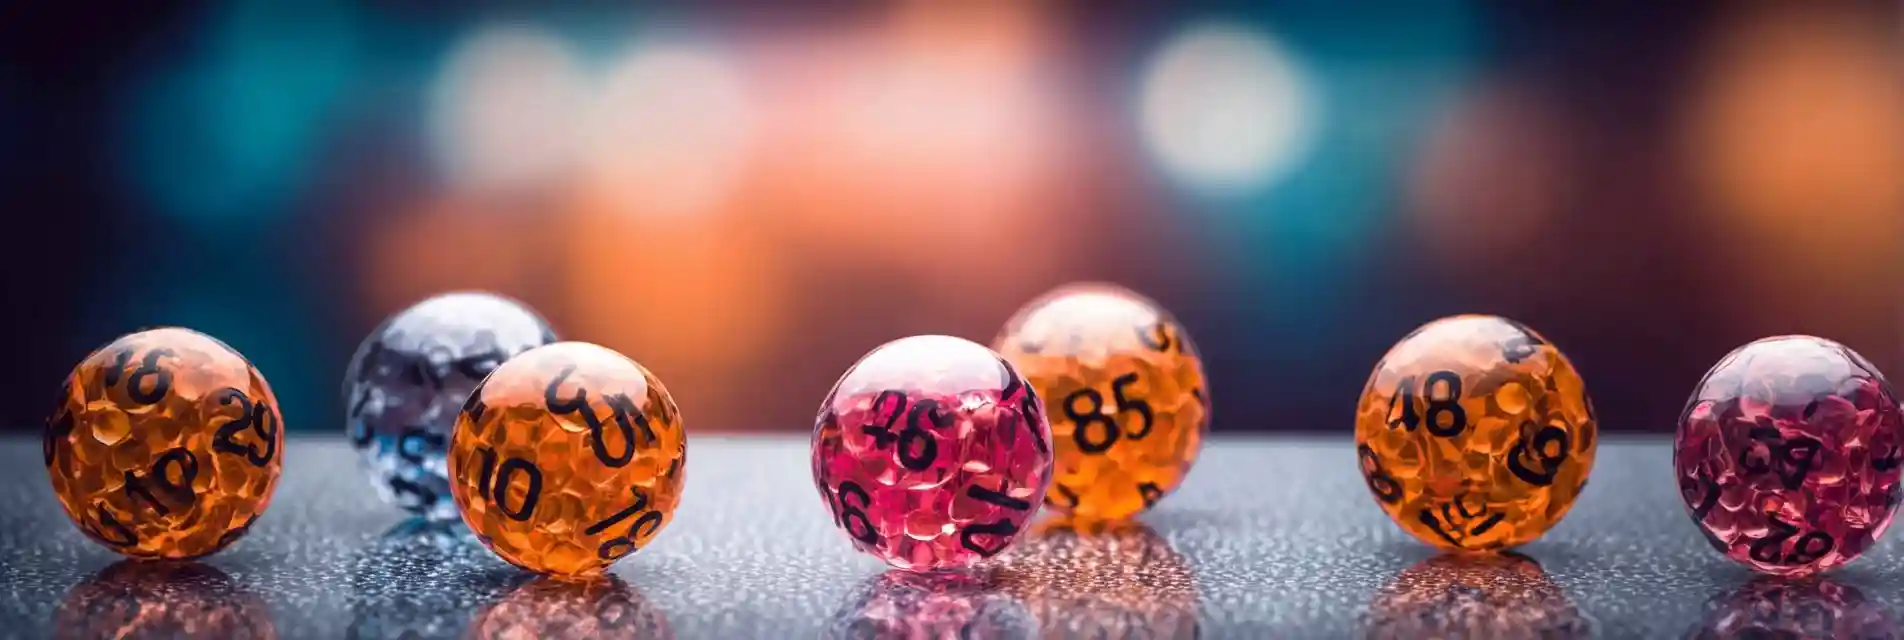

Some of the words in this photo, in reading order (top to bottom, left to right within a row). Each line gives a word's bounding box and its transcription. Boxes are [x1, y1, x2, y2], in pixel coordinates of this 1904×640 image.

[212, 387, 278, 468] 29
[1063, 371, 1154, 456] 85
[472, 446, 544, 522] 10
